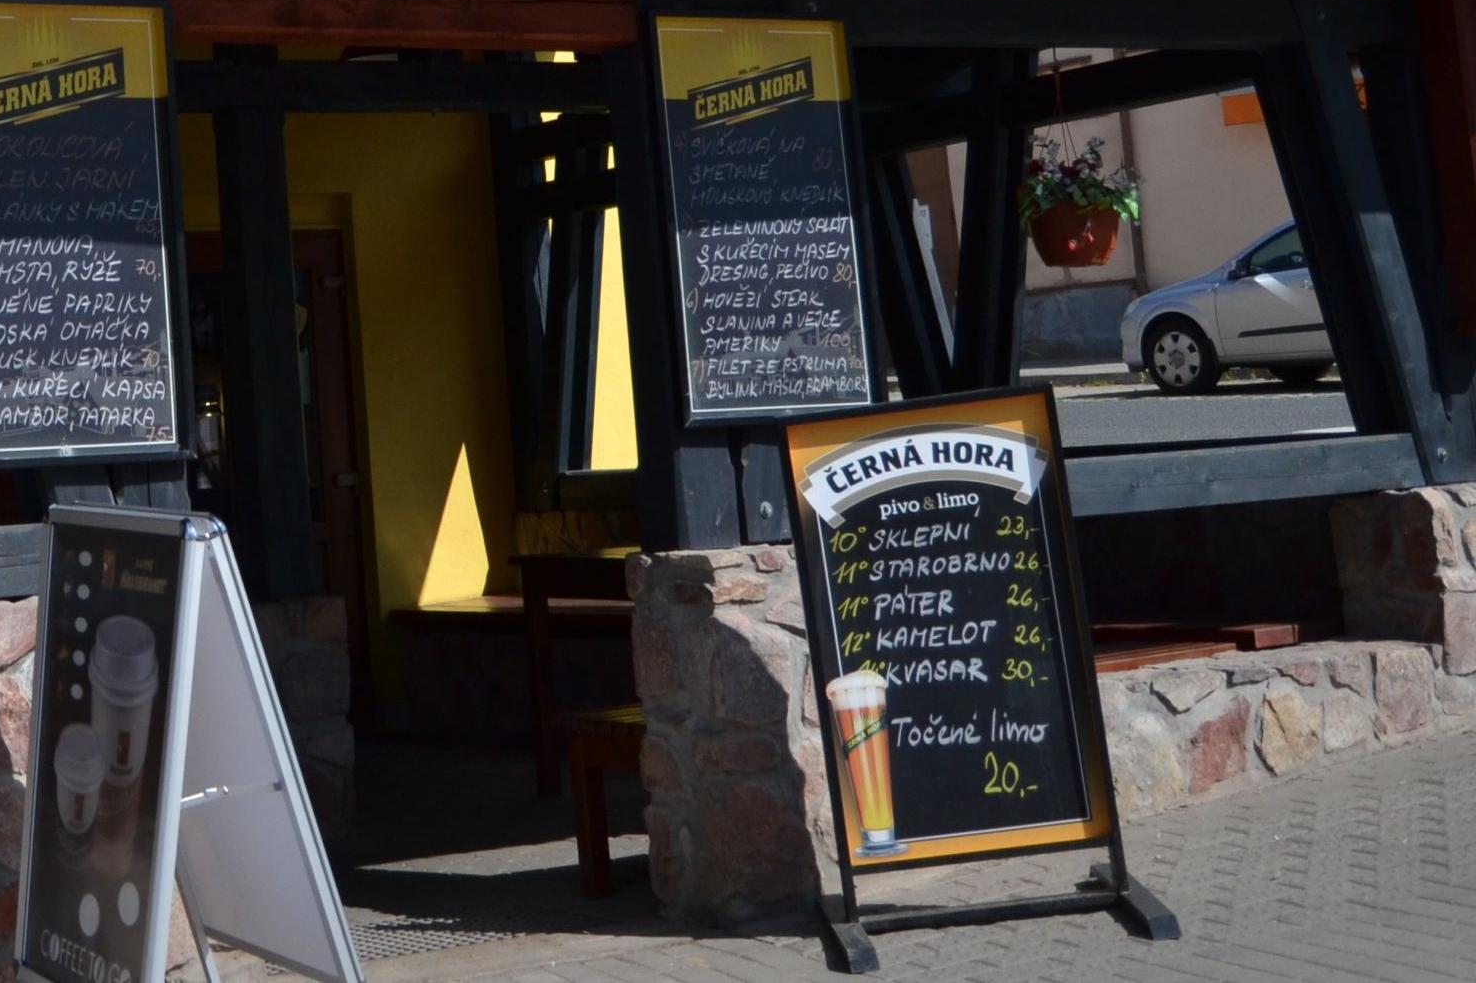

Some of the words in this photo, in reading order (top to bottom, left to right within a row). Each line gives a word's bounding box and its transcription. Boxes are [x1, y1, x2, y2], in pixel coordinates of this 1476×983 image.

[58, 62, 117, 99] HORA
[695, 83, 756, 120] ČERNÁ
[760, 70, 808, 103] HORA
[697, 248, 709, 264] S
[795, 242, 850, 260] MASEM
[64, 293, 152, 315] PAPRIKY
[772, 289, 824, 308] STEAK
[701, 316, 775, 334] SLANINA
[782, 314, 793, 328] A
[797, 310, 842, 328] VEJCE
[707, 359, 748, 377] FILET
[756, 360, 780, 374] ZE
[102, 378, 166, 400] KAPSA
[824, 439, 923, 494] ČERNÁ
[931, 441, 1015, 472] HORA
[879, 496, 920, 519] pivo
[923, 496, 935, 510] &
[936, 492, 979, 510] limo
[869, 552, 1010, 581] STAROBRNO
[877, 620, 996, 651] KAMELOT
[885, 658, 988, 686] KVASAR
[891, 712, 981, 747] Točené
[990, 708, 1050, 744] limo
[41, 928, 85, 976] COFFEE
